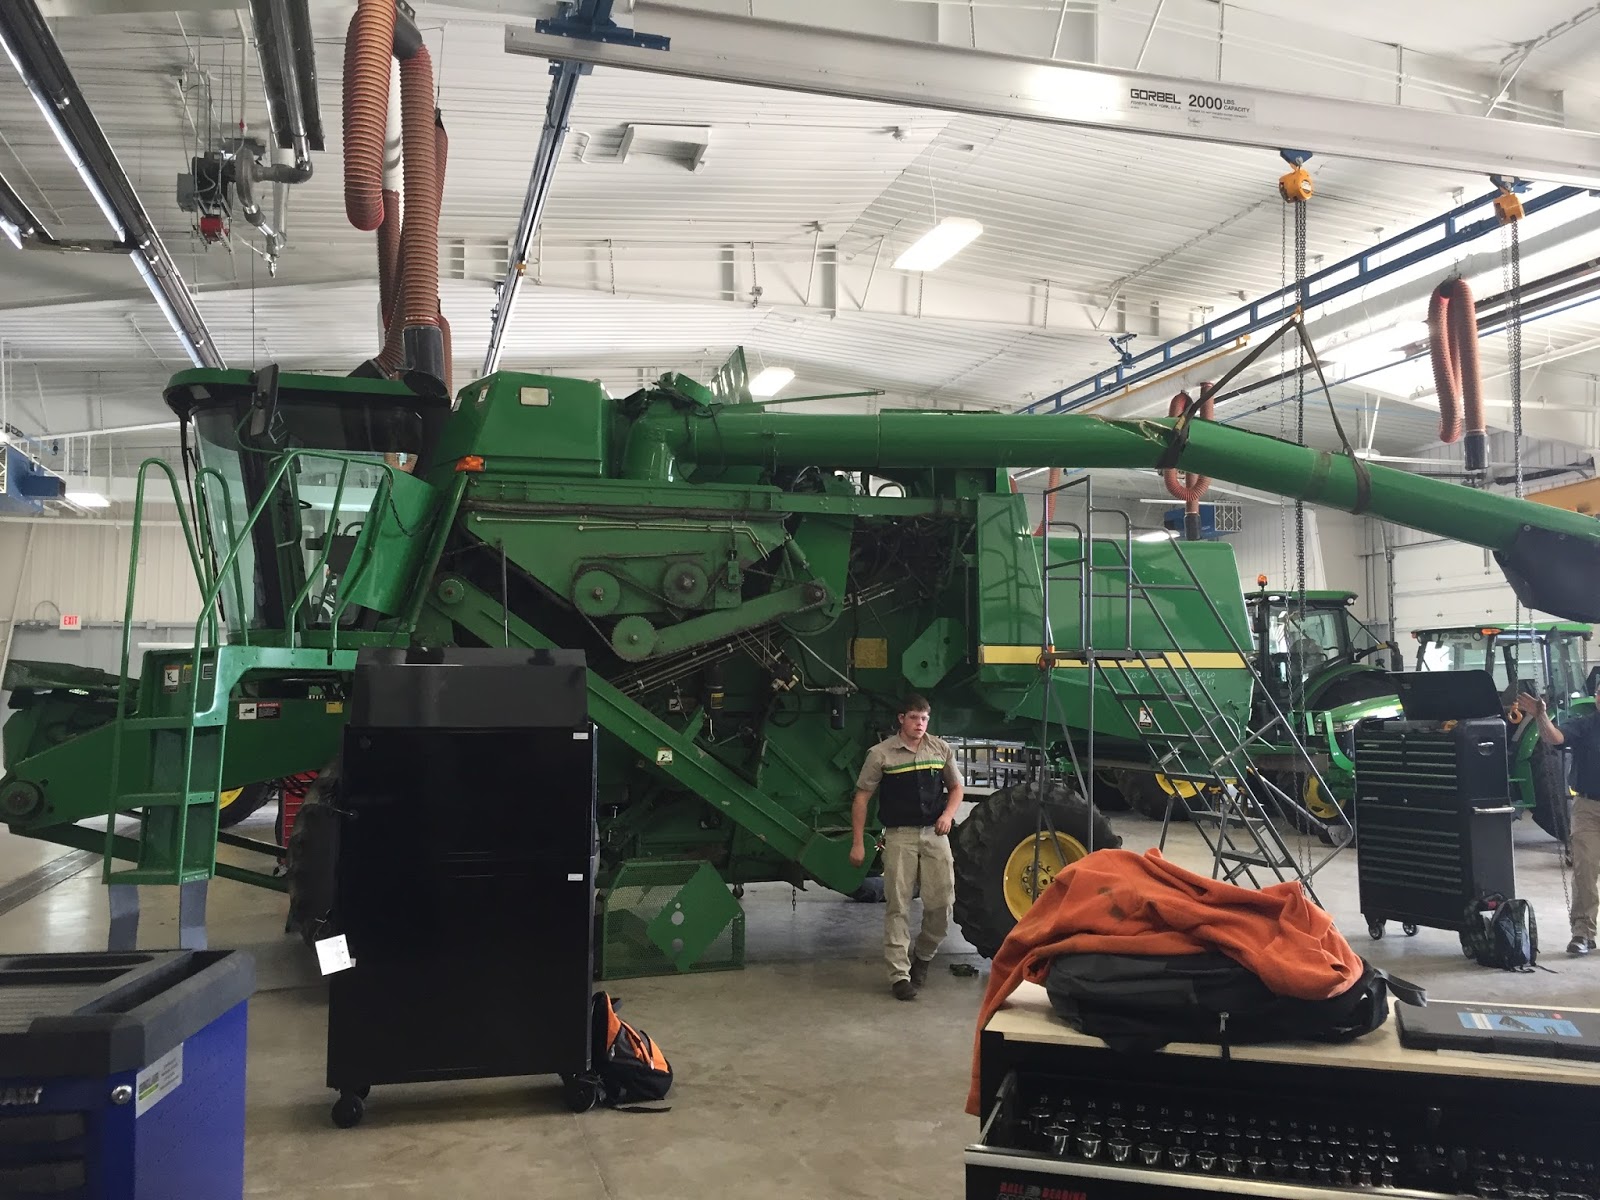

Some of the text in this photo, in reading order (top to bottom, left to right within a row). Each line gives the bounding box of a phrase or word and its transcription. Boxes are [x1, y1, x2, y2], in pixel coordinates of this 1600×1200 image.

[1130, 88, 1181, 104] GORBEL
[1188, 94, 1222, 110] 2000
[1223, 105, 1250, 113] CAPACITY
[64, 616, 78, 625] EXIT
[1000, 1182, 1024, 1194] BALL
